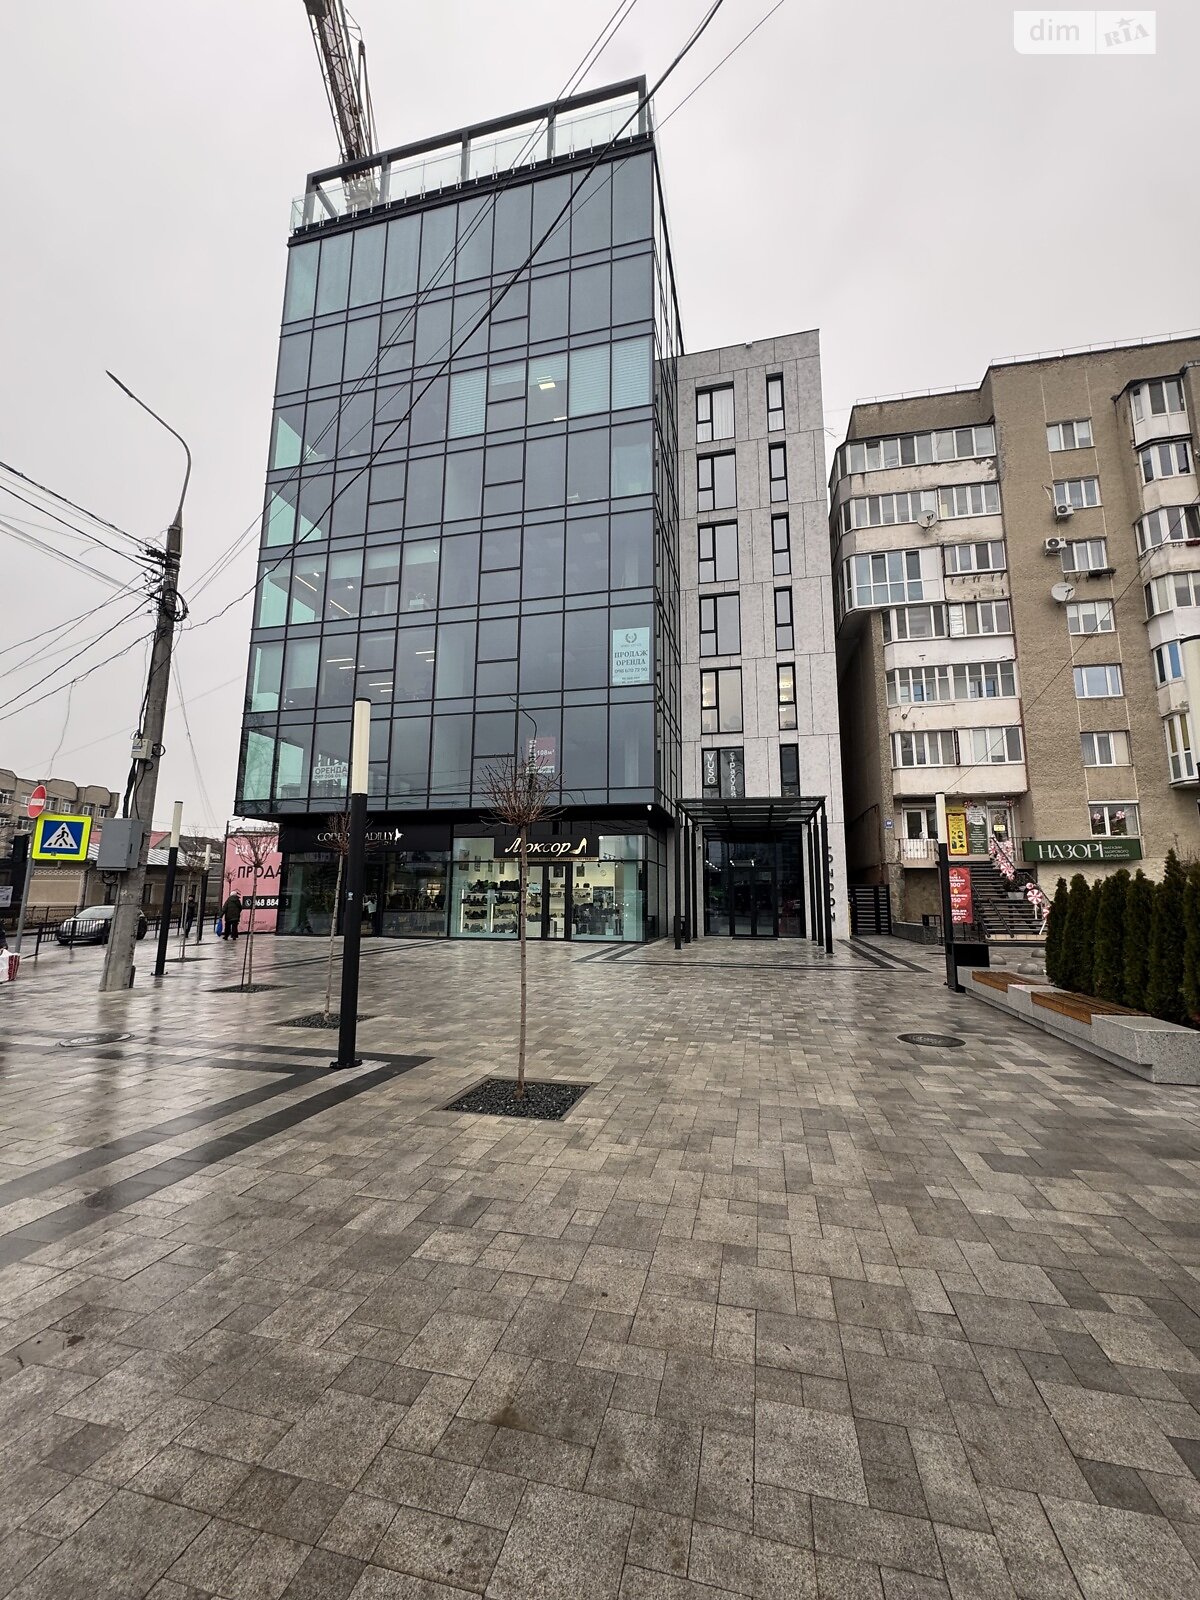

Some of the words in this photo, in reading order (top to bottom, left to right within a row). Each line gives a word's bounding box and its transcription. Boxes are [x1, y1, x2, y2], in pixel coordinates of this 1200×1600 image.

[614, 650, 648, 659] ПРОДАЖ
[616, 658, 646, 666] ОРЕНДА
[315, 766, 348, 775] ОРЕНДА
[707, 753, 716, 784] VUSO
[1039, 841, 1104, 859] НАЗОРІ
